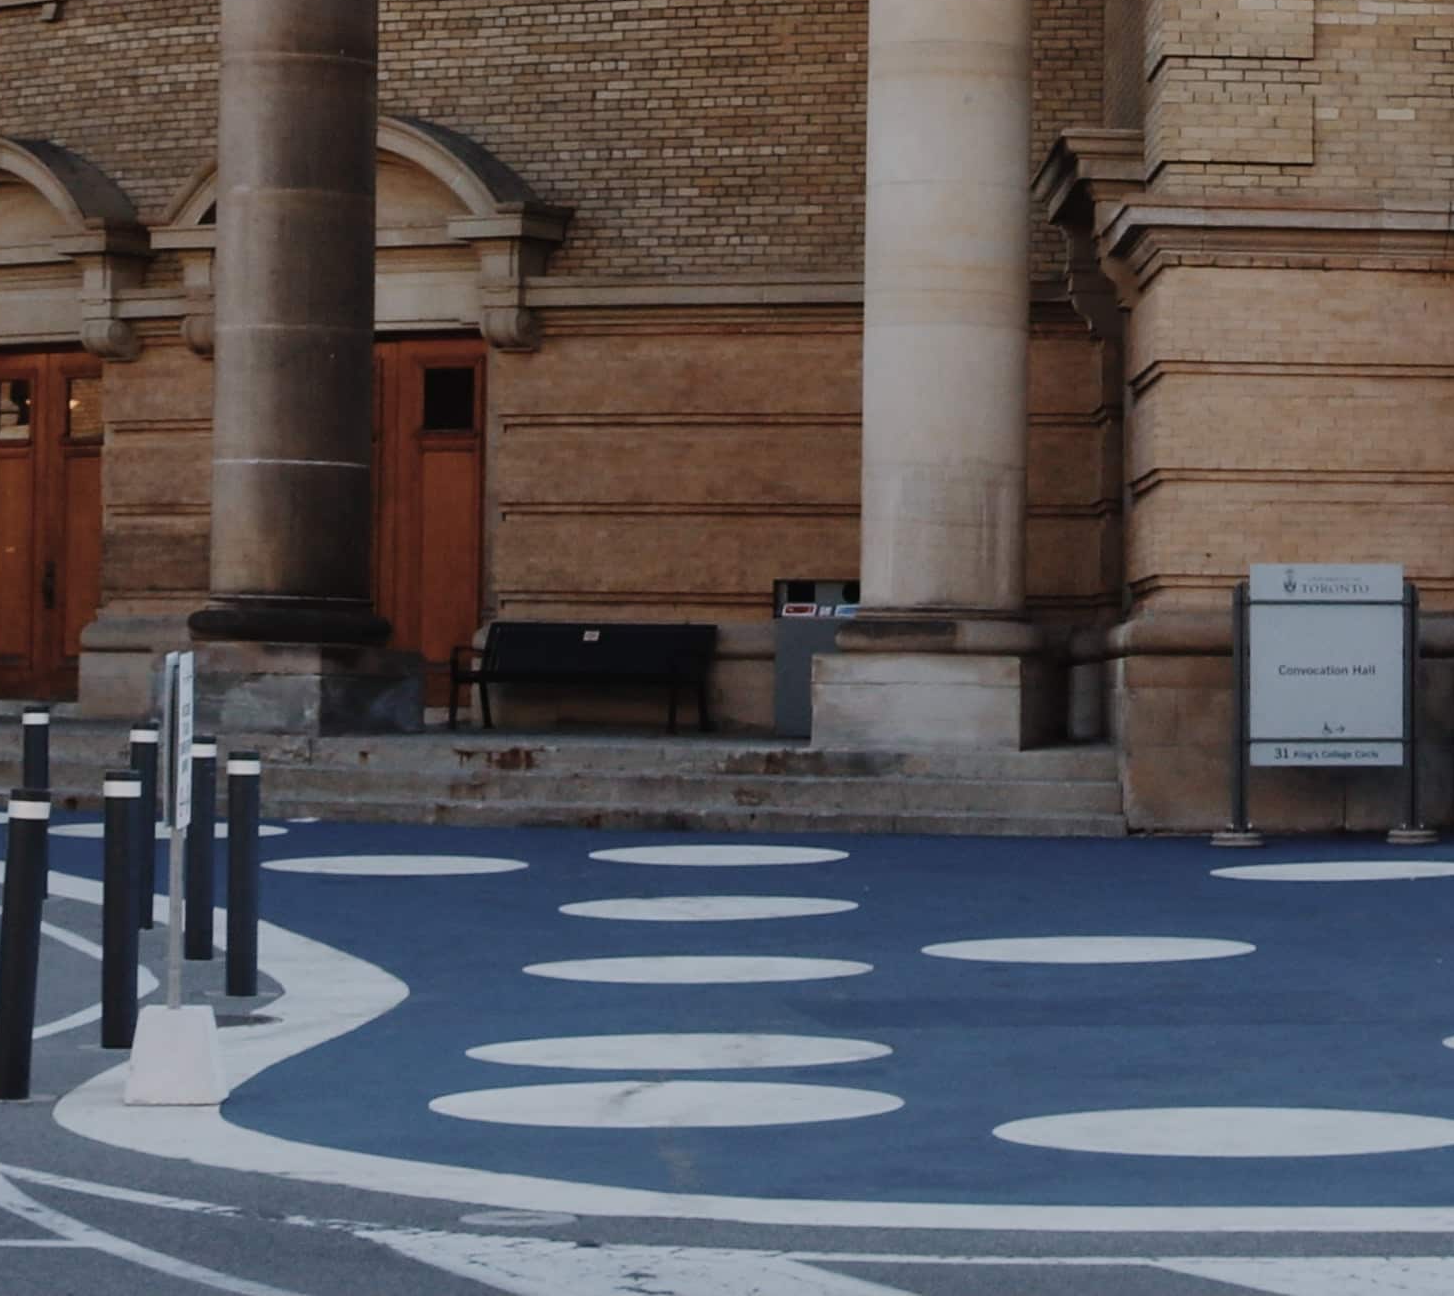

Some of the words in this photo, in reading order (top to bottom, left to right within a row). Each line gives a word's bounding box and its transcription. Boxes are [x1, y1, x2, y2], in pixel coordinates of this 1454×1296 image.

[1301, 584, 1370, 594] TORONTO
[1278, 664, 1348, 676] Convocation
[1352, 664, 1376, 676] Hall
[1274, 747, 1289, 760] 31
